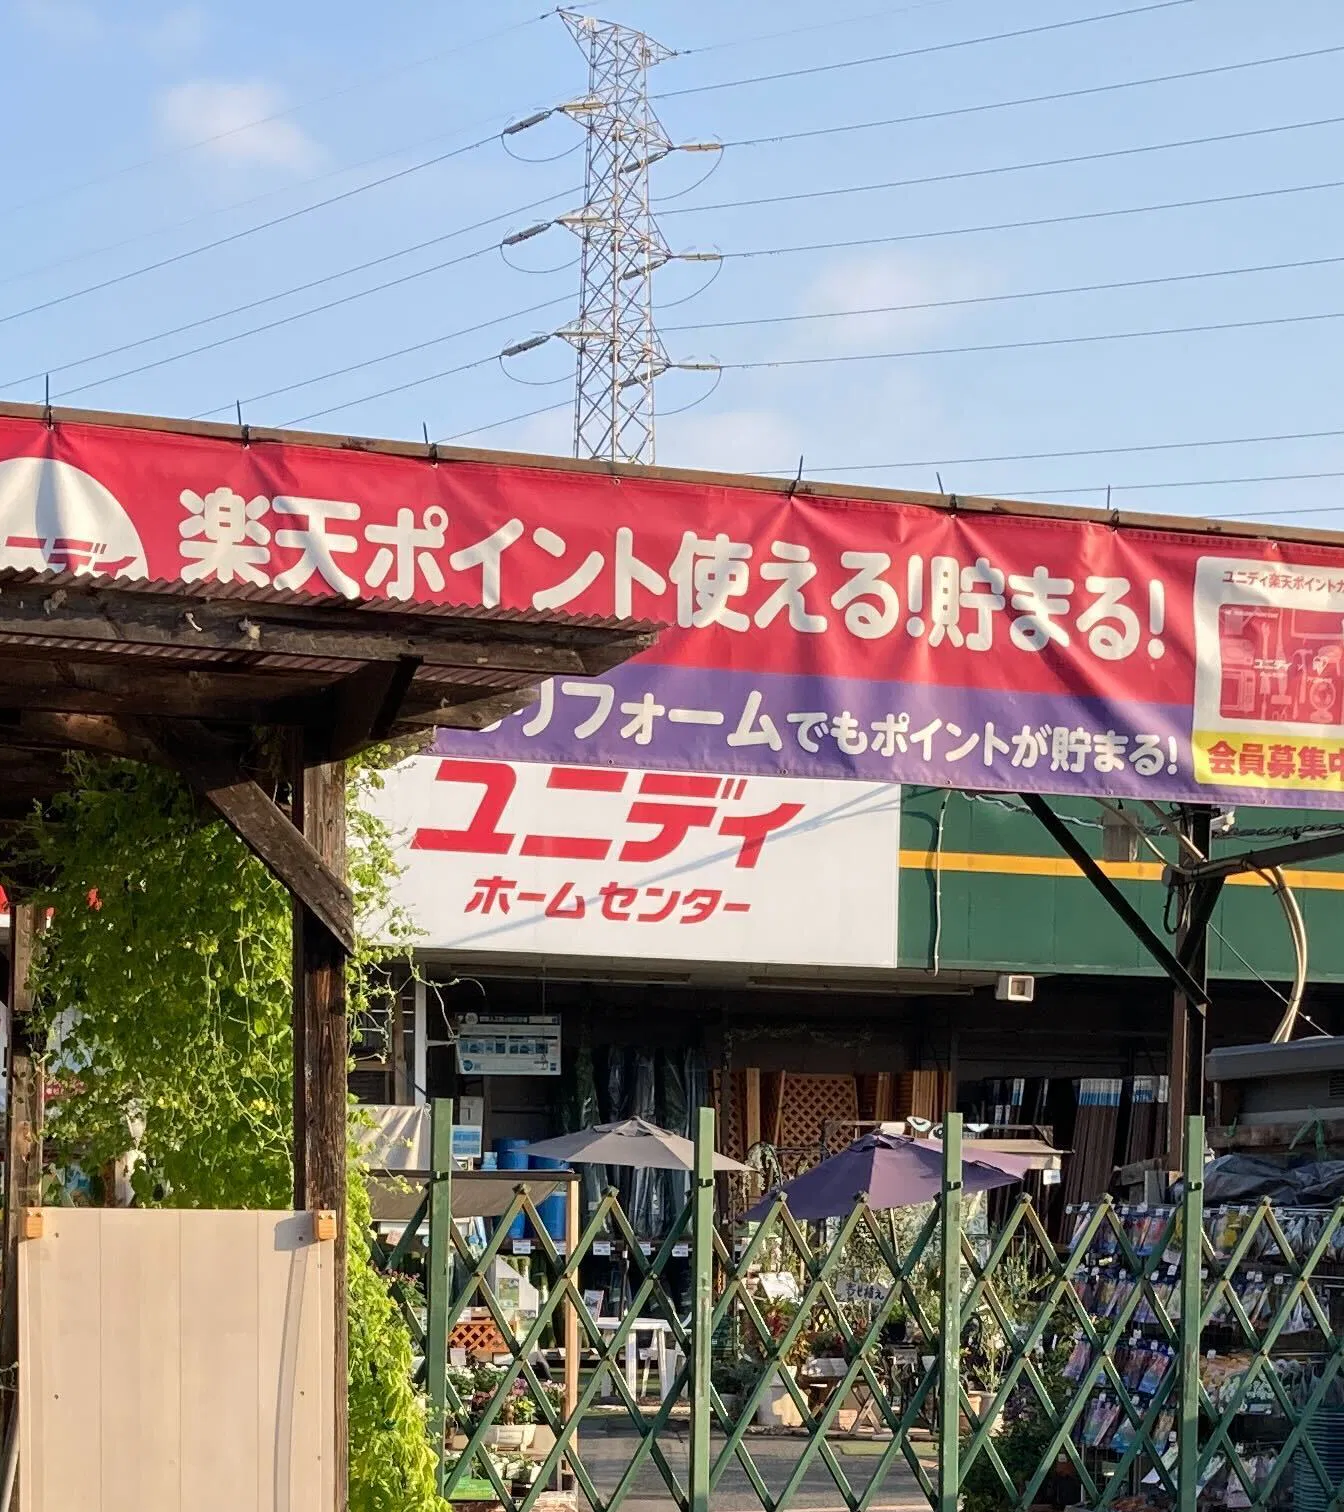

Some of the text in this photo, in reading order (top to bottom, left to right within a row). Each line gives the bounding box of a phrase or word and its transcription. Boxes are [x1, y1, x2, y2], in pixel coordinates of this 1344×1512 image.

[178, 486, 1167, 660] 楽天ポイント使える!貯まる!
[480, 677, 1178, 776] リフォームでもポイントが貯まる!
[410, 758, 805, 869] ユニディ
[464, 874, 756, 925] ホームセンター
